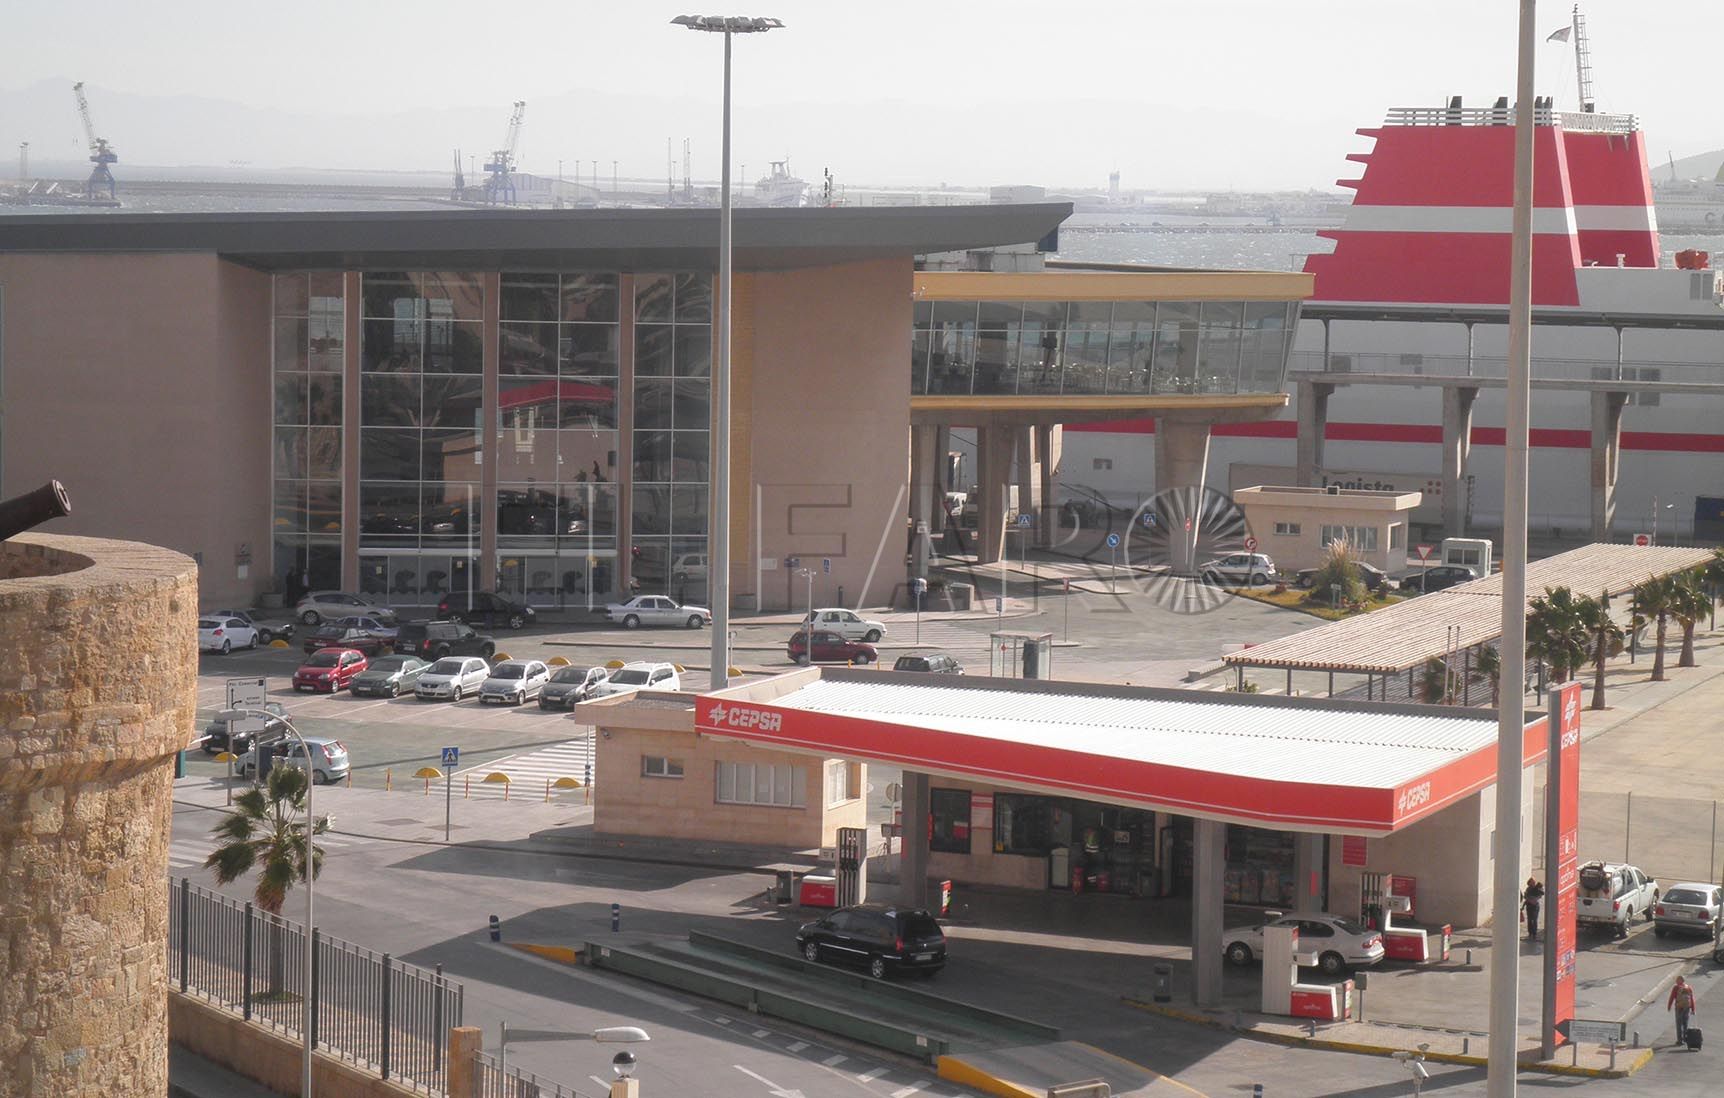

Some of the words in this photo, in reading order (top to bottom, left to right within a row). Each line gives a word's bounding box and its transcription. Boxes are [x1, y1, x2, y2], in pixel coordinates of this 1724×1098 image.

[728, 707, 782, 732] CEPSA
[1561, 728, 1578, 750] CEPSA
[1407, 781, 1431, 810] CEPSA
